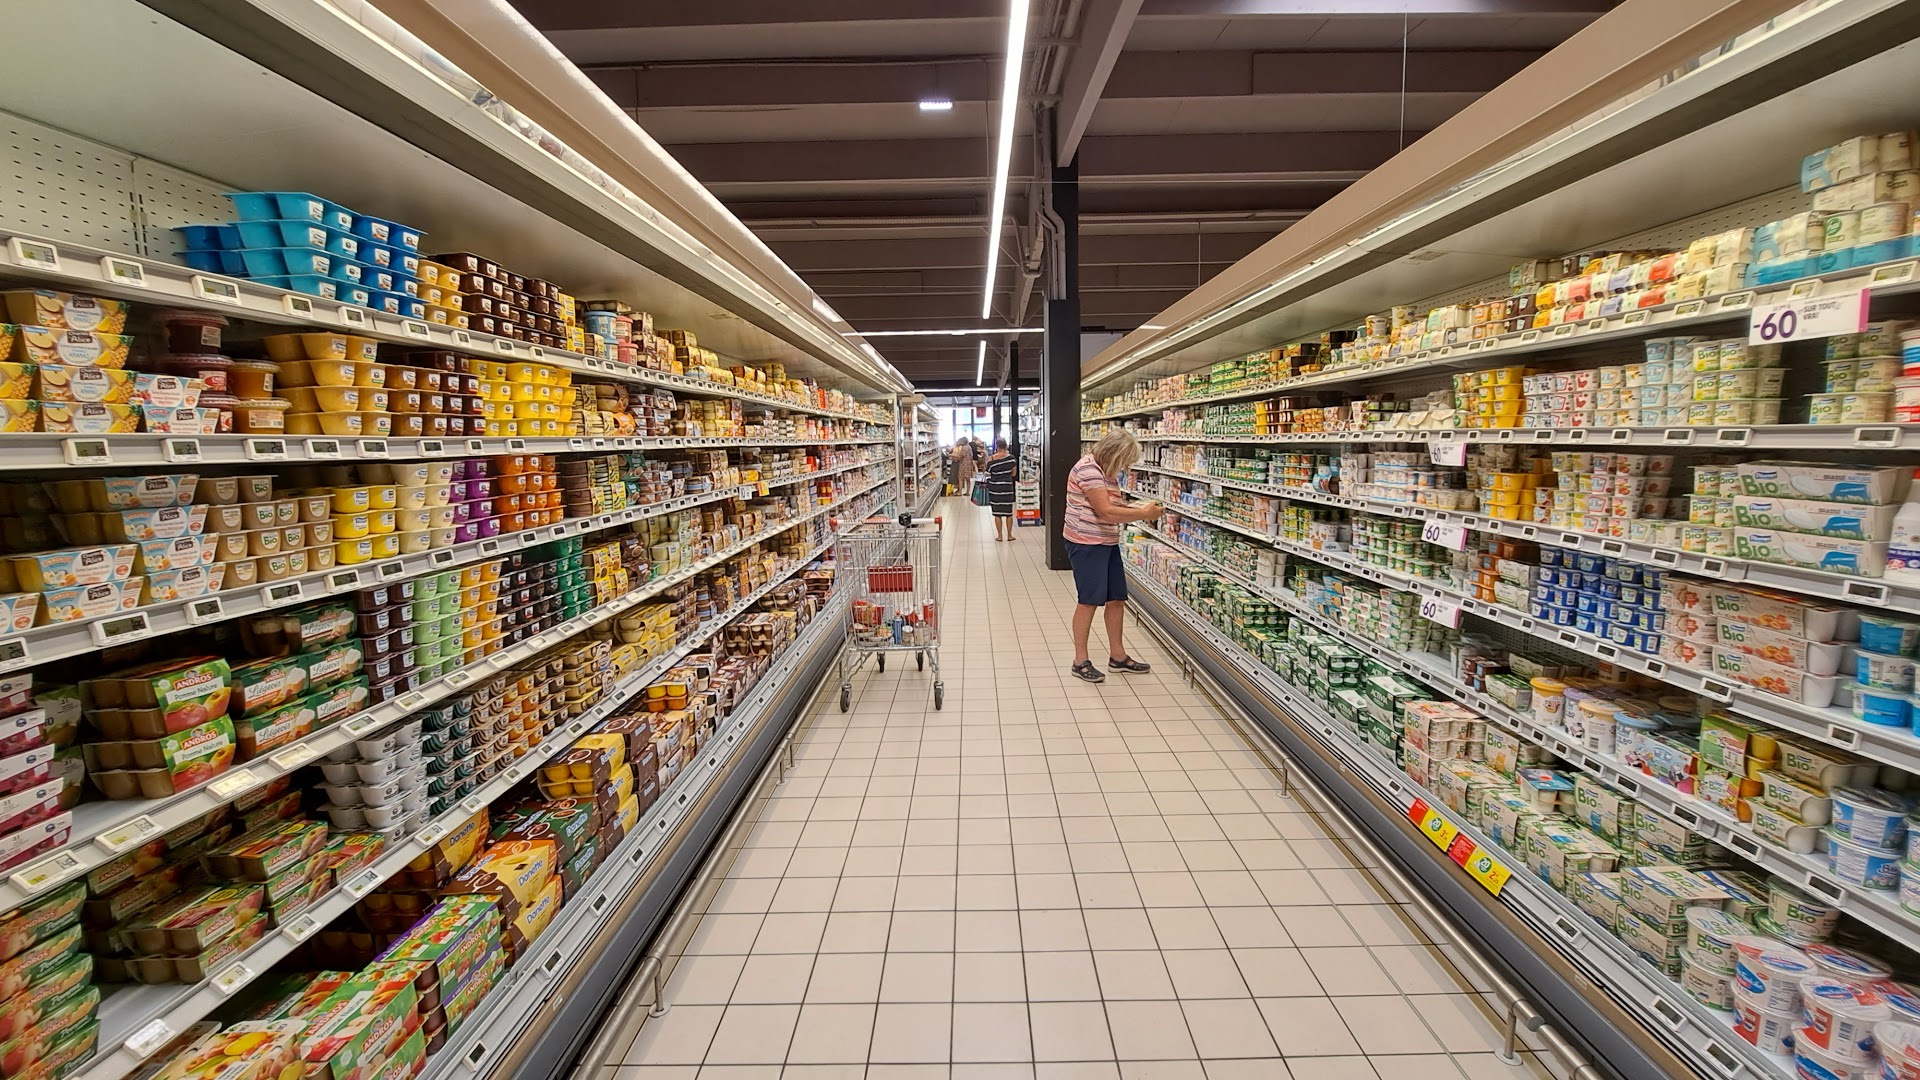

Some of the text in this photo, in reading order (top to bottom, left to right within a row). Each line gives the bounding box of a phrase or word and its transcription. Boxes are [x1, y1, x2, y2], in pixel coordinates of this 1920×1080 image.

[1753, 310, 1797, 341] -60
[1424, 525, 1440, 542] -60
[1422, 602, 1436, 618] -60
[175, 672, 212, 690] ANDROS
[183, 730, 218, 749] ANDROS
[450, 822, 475, 846] Danette
[518, 860, 543, 886] Danette
[526, 896, 550, 924] Danette
[364, 1016, 394, 1051] ANDROS
